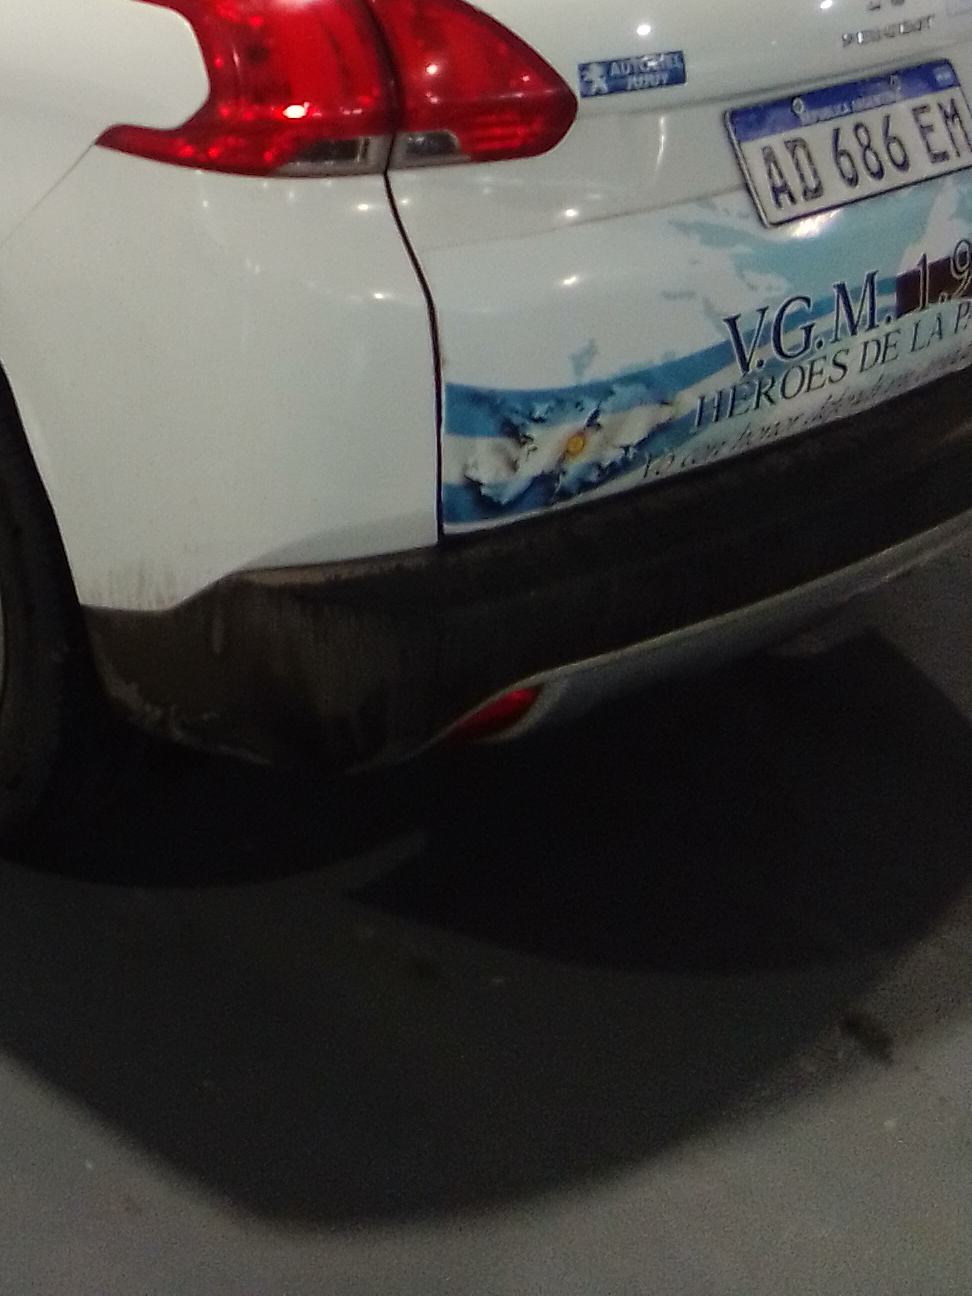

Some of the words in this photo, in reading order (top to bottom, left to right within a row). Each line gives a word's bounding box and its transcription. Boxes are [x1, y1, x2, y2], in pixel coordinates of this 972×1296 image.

[761, 137, 824, 209] AD
[832, 115, 910, 189] 686
[912, 98, 972, 164] EM
[691, 348, 850, 427] HEROES
[859, 329, 901, 373] DE
[910, 311, 943, 353] LA
[724, 270, 892, 376] V.G.M.
